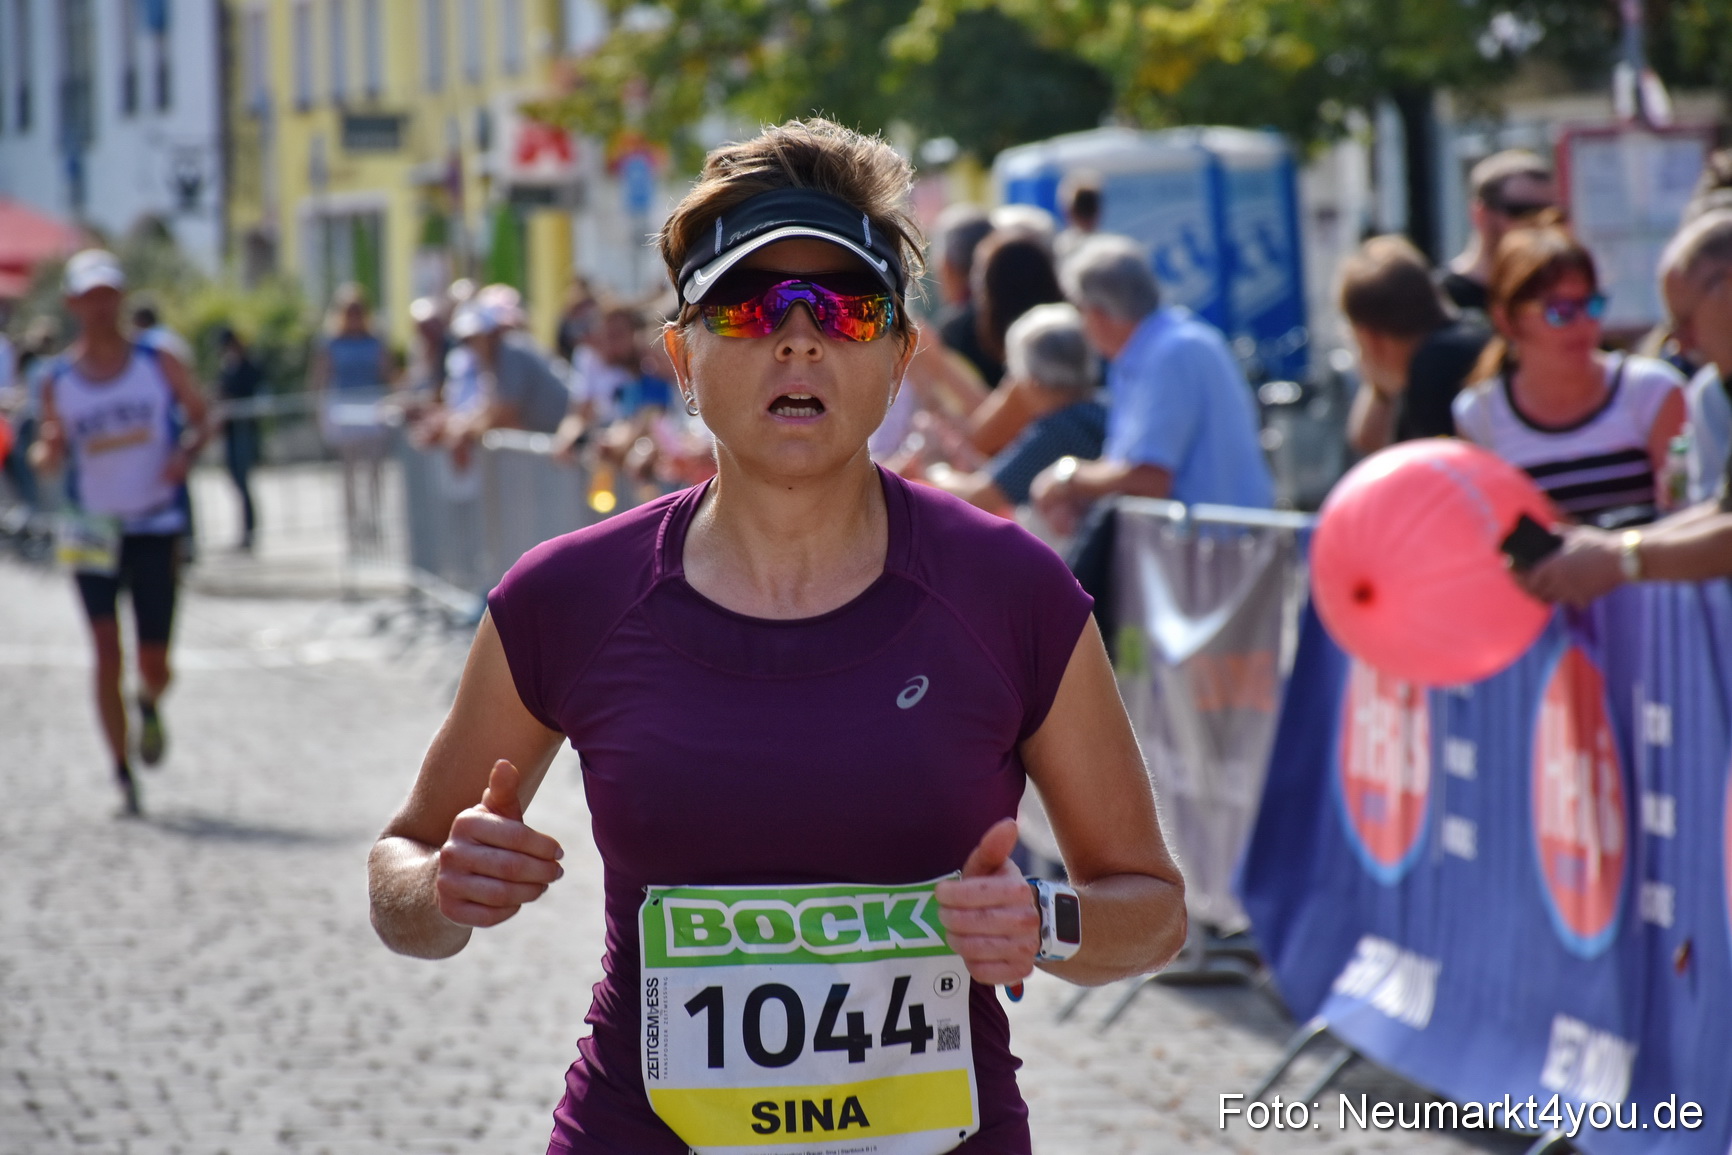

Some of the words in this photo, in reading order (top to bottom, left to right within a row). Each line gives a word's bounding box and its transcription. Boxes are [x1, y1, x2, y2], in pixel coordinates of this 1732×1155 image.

[664, 892, 945, 957] BOCK
[941, 977, 954, 992] B
[684, 975, 934, 1069] 1044
[751, 1095, 870, 1134] SINA
